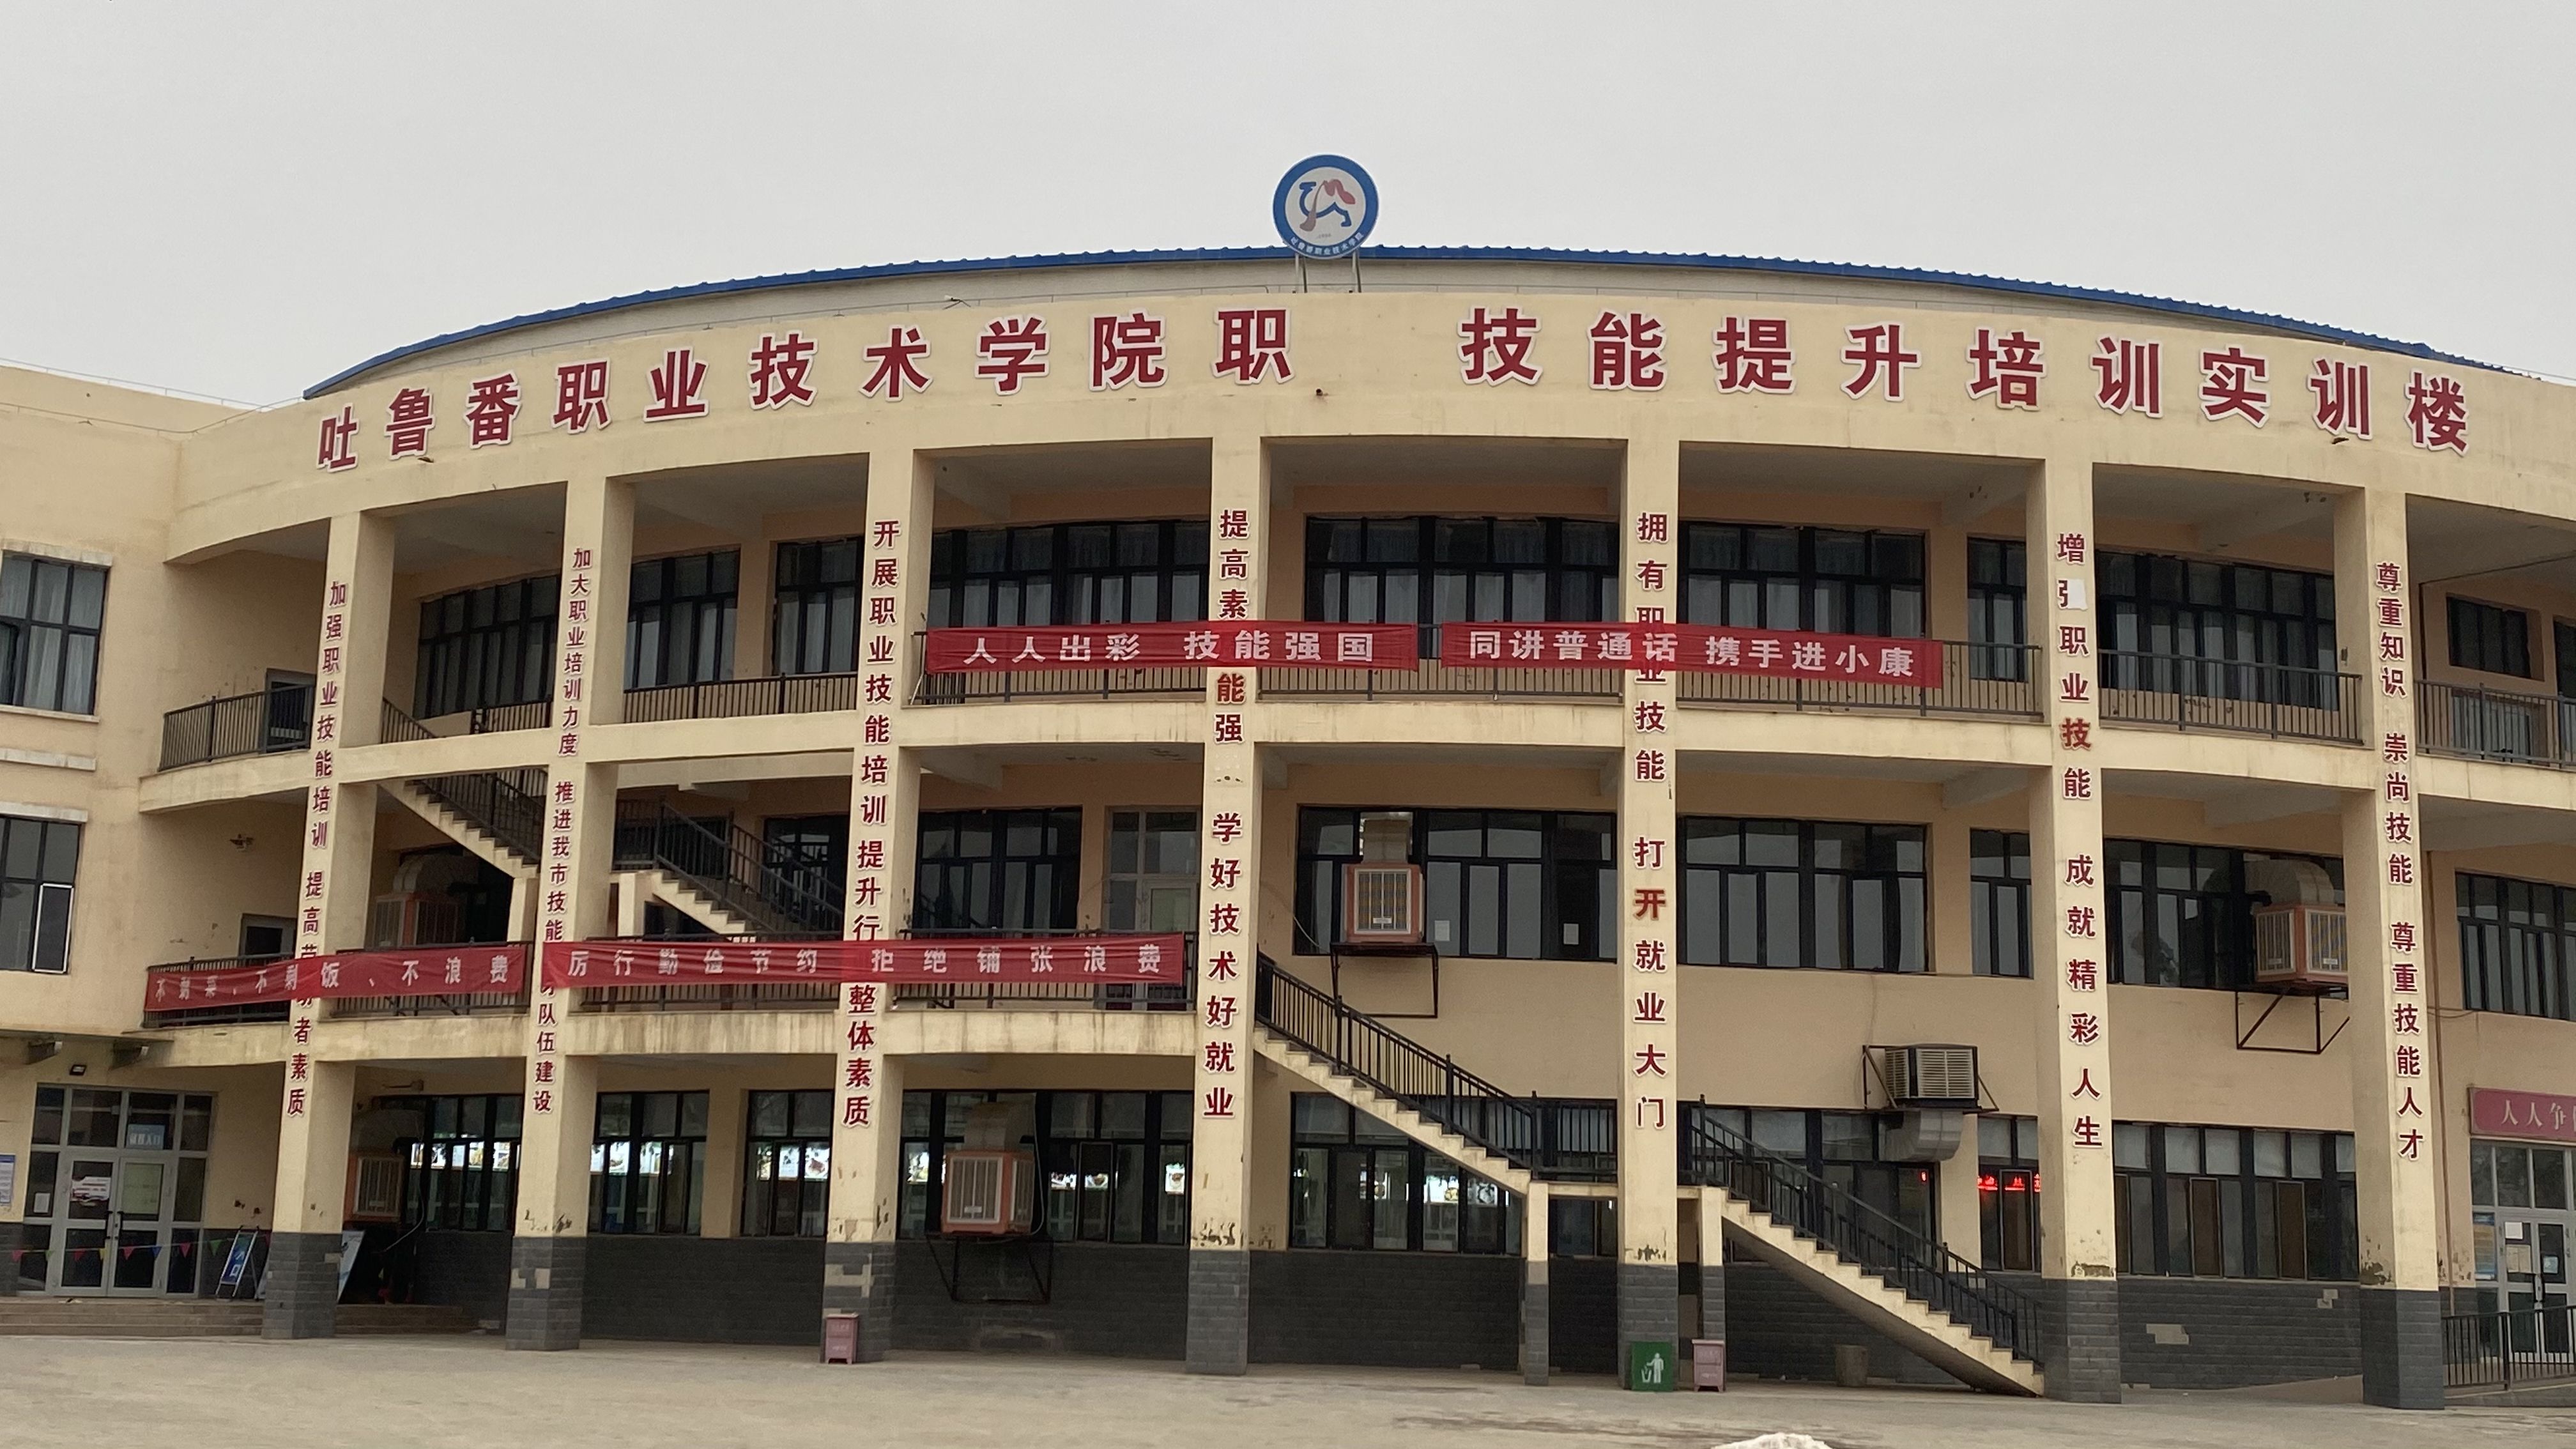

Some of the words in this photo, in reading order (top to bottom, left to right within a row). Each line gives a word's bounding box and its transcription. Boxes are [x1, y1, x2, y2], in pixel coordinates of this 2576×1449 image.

[317, 309, 1292, 471] 吐鲁番职业技术学院职
[1462, 307, 2468, 451] 技能提升培训实训楼
[312, 581, 346, 848] 加强职业技能培训
[560, 548, 590, 756] 加大职业培训力度
[859, 519, 900, 825] 开展职业技能培训
[963, 632, 1141, 665] 人人出彩
[1183, 629, 1375, 665] 技能强国
[1215, 509, 1249, 742] 提高素能强
[1468, 629, 1679, 663] 同讲普通话
[1705, 635, 1915, 678] 携手进小康
[2376, 562, 2407, 699] 尊重知识
[2383, 732, 2414, 885] 崇尚技能
[533, 781, 574, 1112] 推进我市技能队伍建设
[567, 947, 818, 977] 厉行勤俭节约
[870, 944, 1162, 975] 拒绝铺张浪费
[843, 839, 885, 1126] 提升行整体素质
[1203, 811, 1242, 1118] 学好技术好就业
[1634, 836, 1667, 1130] 打开就业大门
[2066, 854, 2104, 1149] 成就精彩人生
[2391, 921, 2425, 1160] 尊重技能人才
